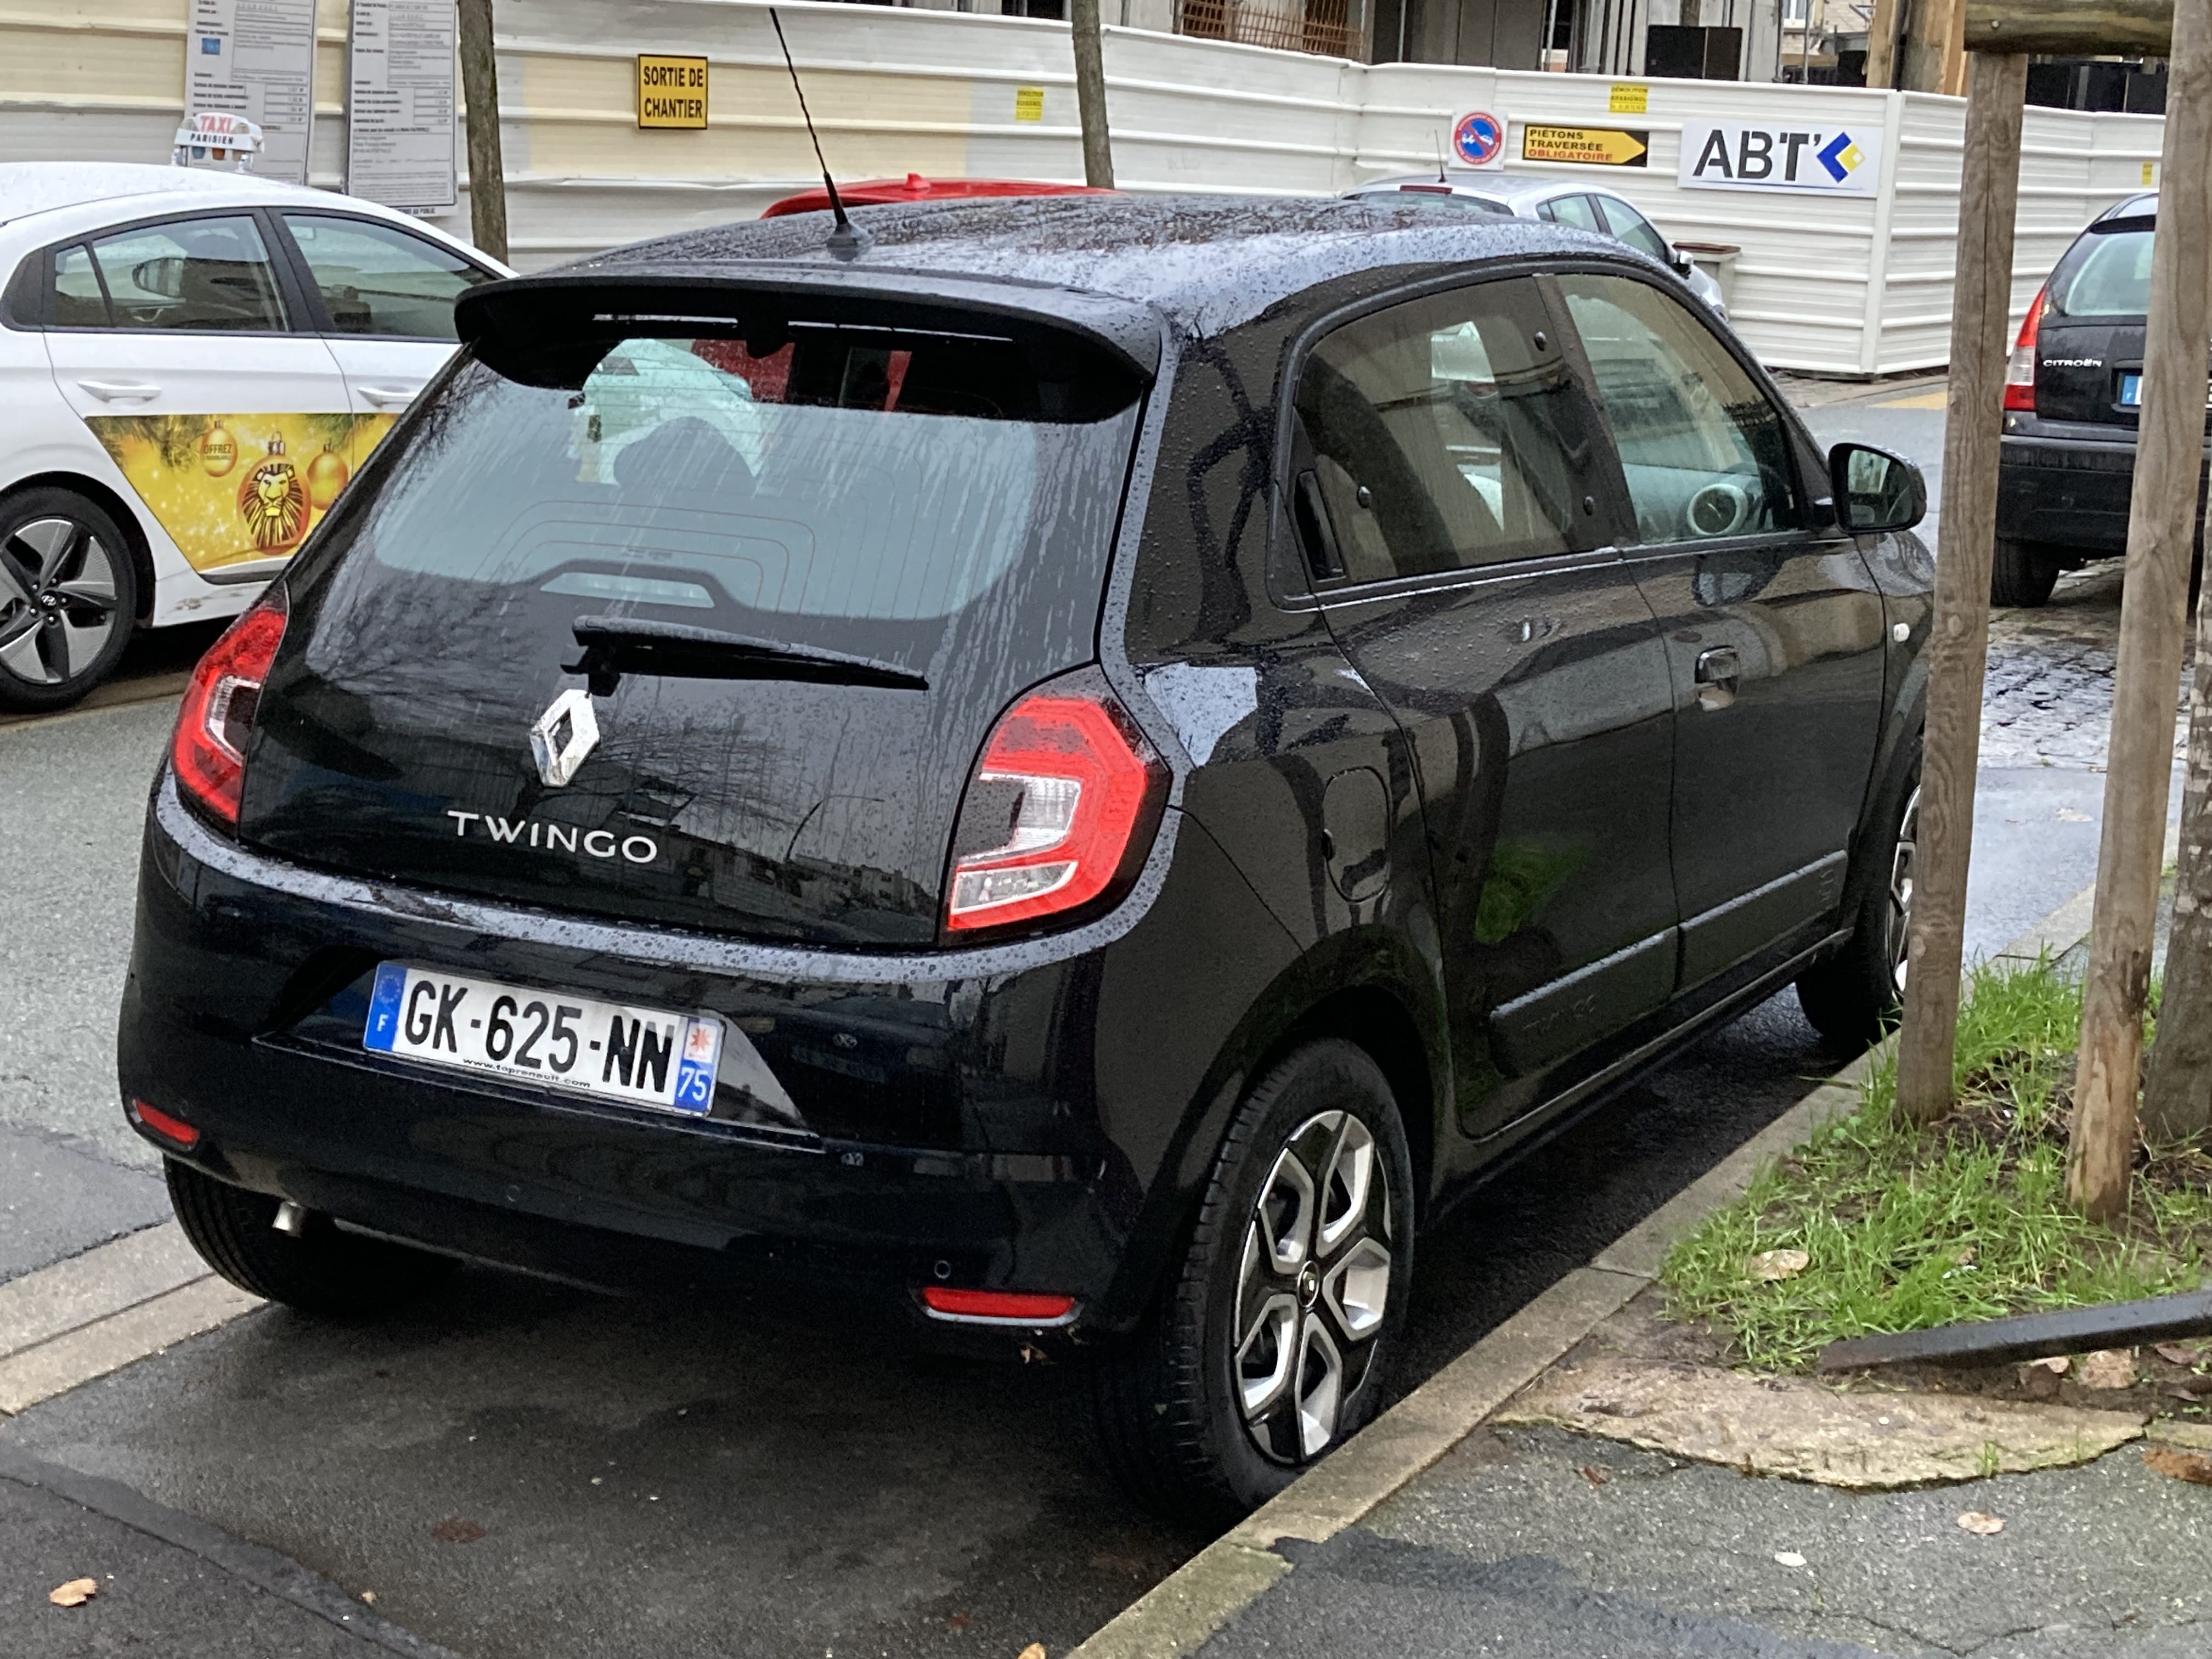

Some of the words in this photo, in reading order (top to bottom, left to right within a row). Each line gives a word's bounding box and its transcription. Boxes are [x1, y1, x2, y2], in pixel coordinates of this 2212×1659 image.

[644, 66, 685, 87] SORTIE
[689, 68, 703, 87] DE
[644, 98, 703, 119] CHANTIER
[200, 115, 232, 133] TAXI
[190, 133, 234, 144] PARISIEN
[1529, 139, 1604, 151] TRAVERSÉE
[1528, 149, 1613, 161] OBLIGATOIRE
[2042, 358, 2102, 367] CITROËN
[204, 444, 232, 454] OFFREZ
[447, 810, 657, 864] TWINGO
[377, 1013, 389, 1032] F
[404, 980, 676, 1093] GK-625-NN
[678, 1066, 709, 1102] 75
